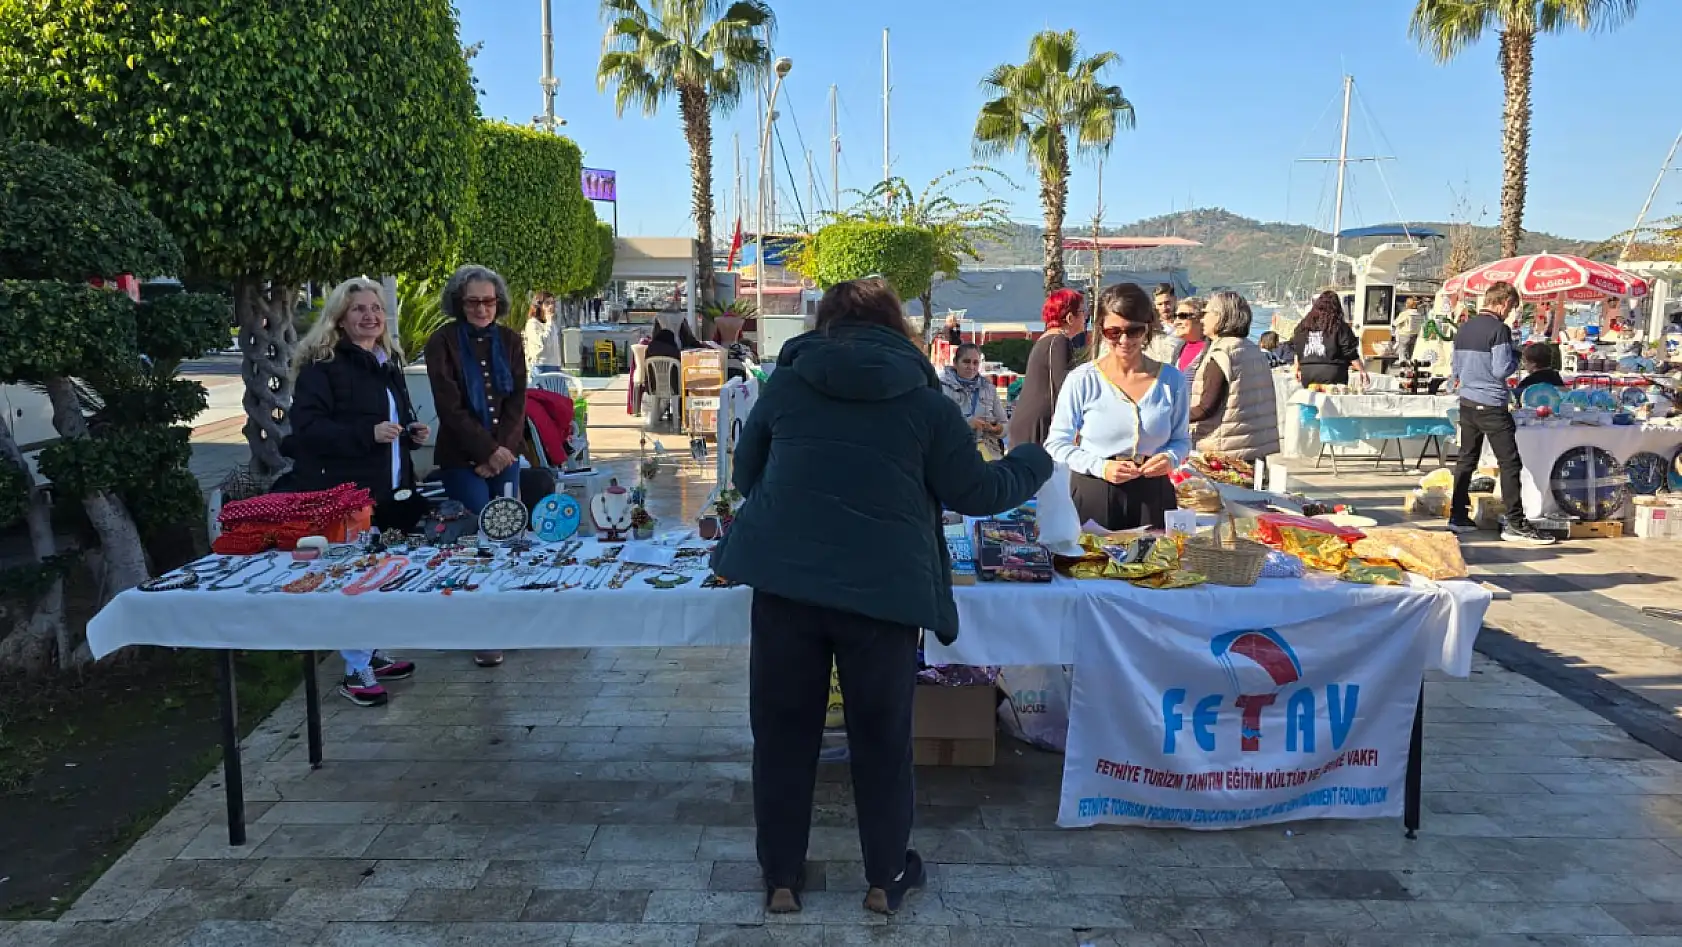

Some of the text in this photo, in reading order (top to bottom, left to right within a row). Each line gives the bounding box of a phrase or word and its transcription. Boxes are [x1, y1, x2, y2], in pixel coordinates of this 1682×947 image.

[1535, 277, 1573, 290] ALGIDA
[1162, 684, 1360, 754] FETAV
[1096, 758, 1142, 784] FETHİYE
[1143, 767, 1185, 791] TURİZM
[1185, 770, 1225, 792] TANITIM
[1225, 766, 1263, 790] EĞİTİM
[1264, 767, 1306, 790] KÜLTÜR
[1347, 748, 1379, 767] VAKFI
